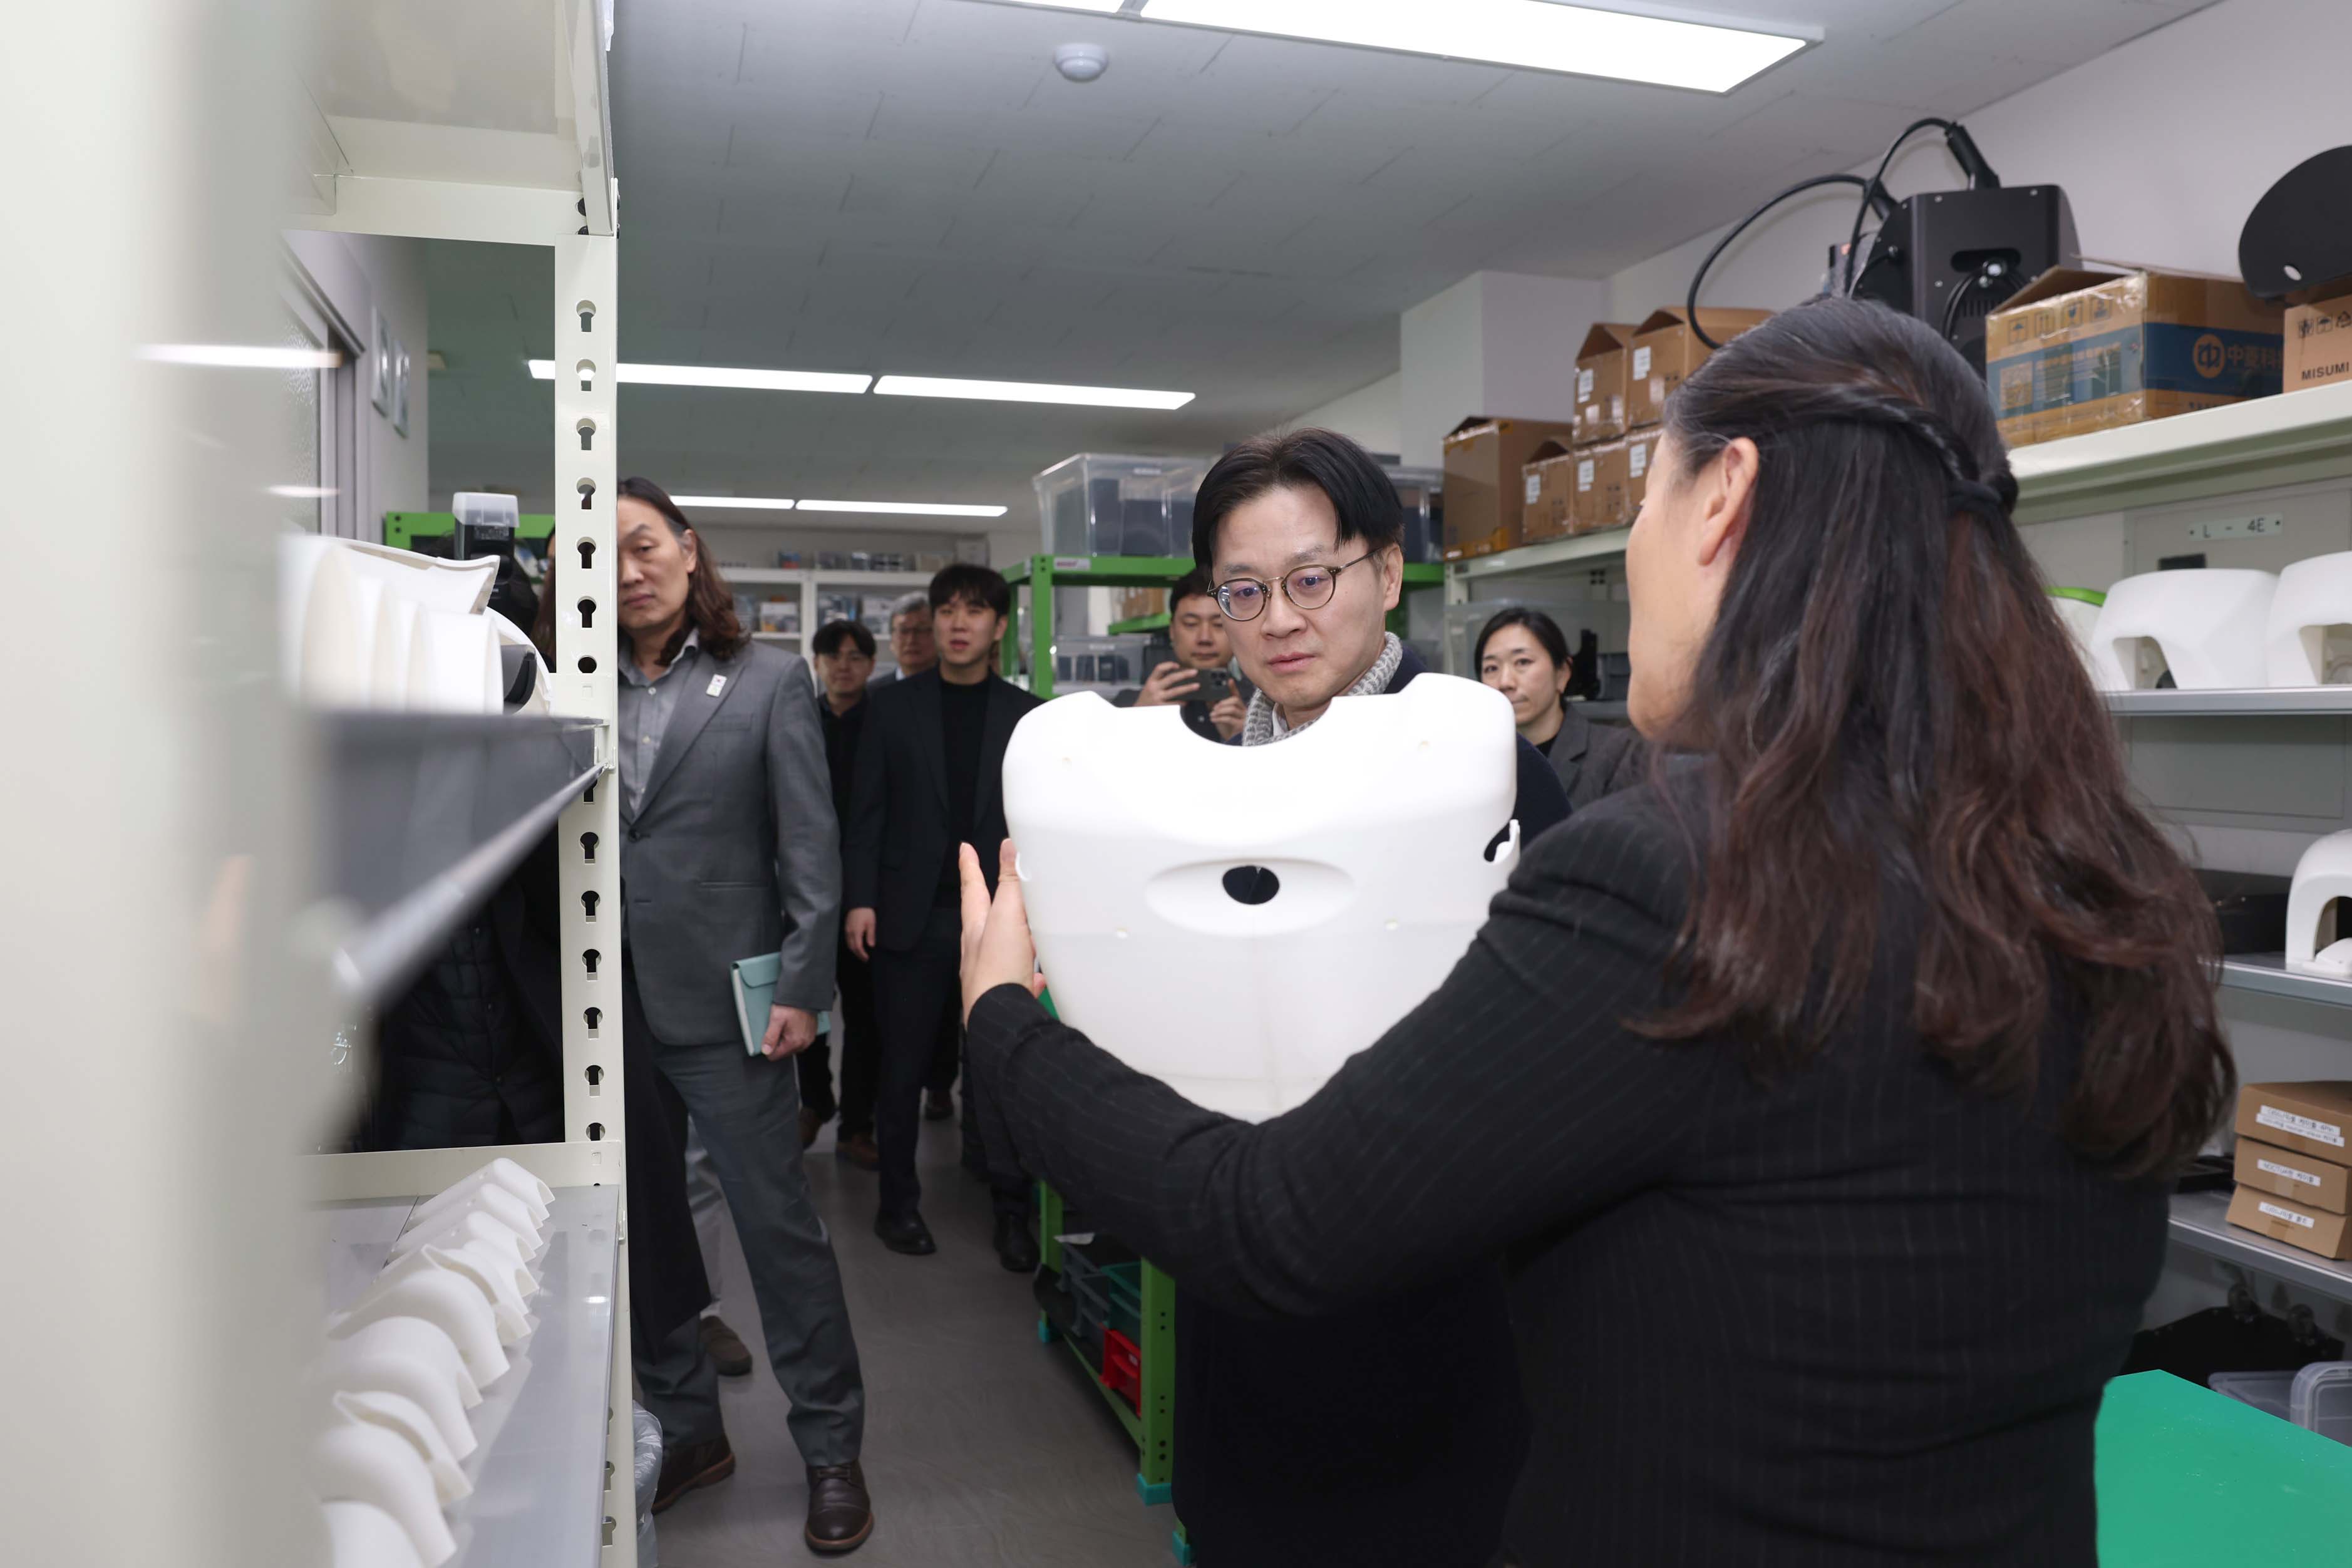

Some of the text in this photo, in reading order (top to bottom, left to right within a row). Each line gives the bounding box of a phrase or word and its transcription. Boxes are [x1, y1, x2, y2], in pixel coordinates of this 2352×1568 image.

[2301, 361, 2349, 381] MISUMI
[2202, 524, 2211, 539] L
[2247, 516, 2266, 533] 4E
